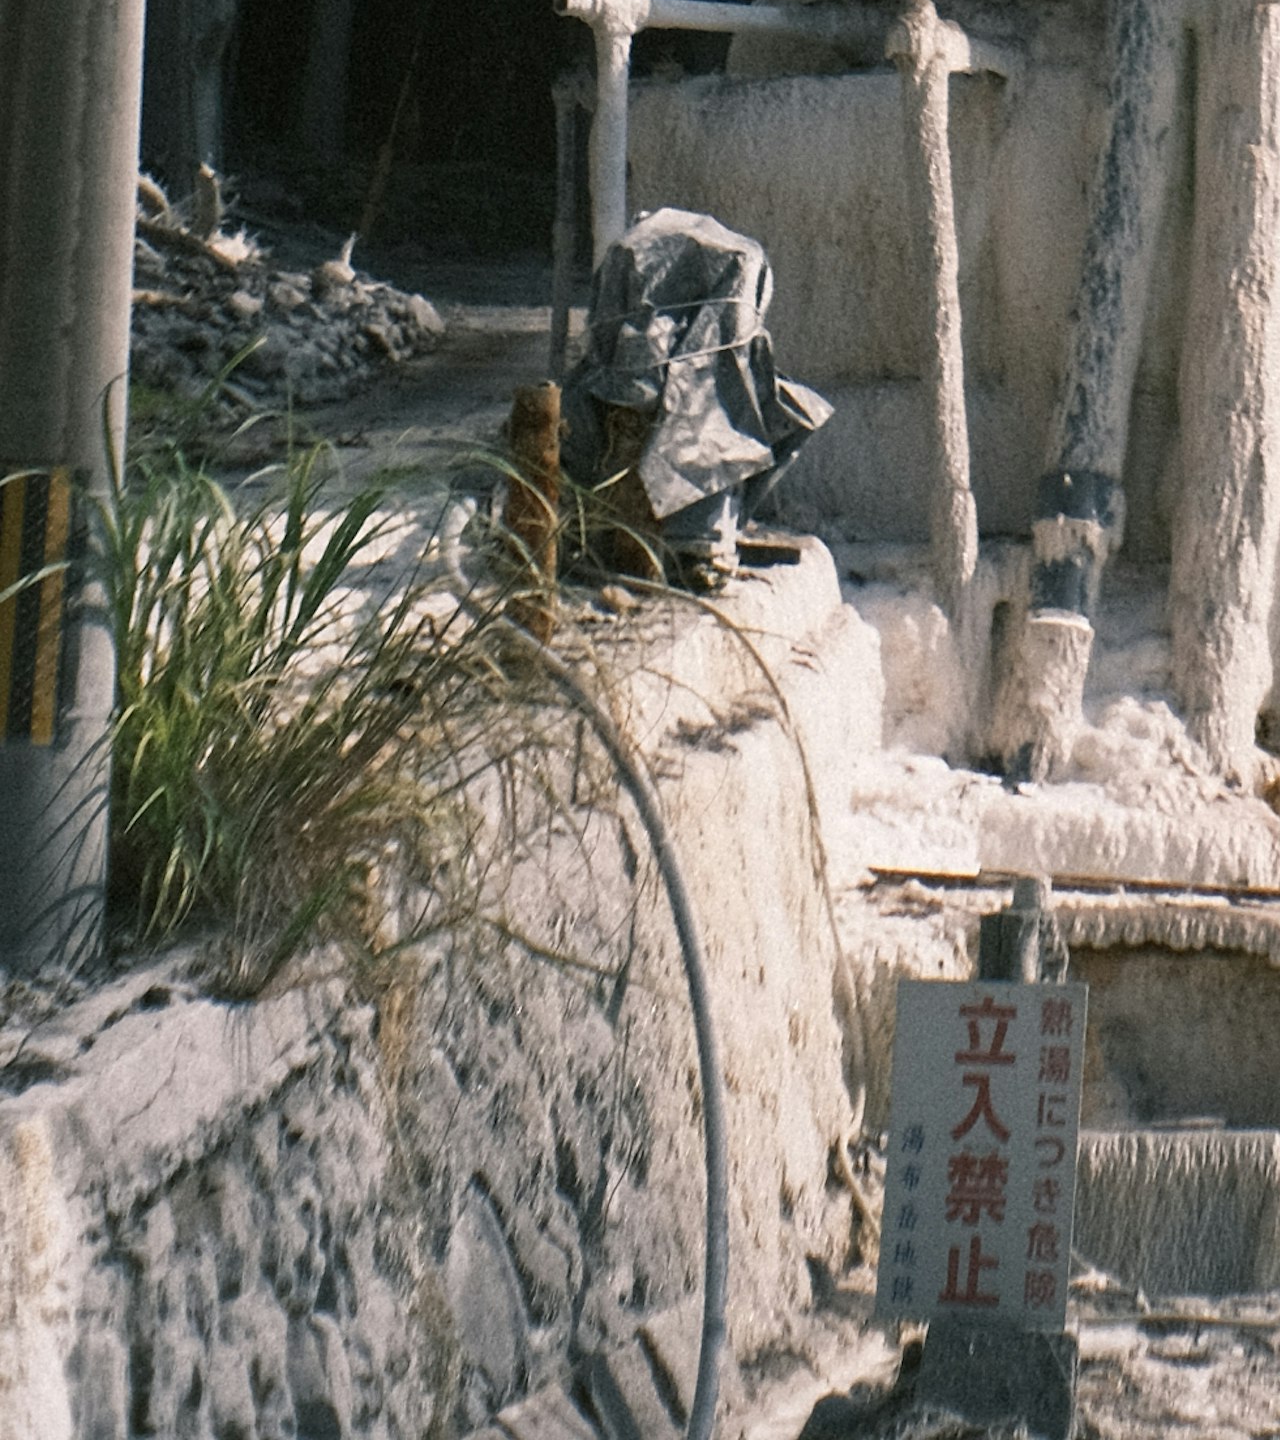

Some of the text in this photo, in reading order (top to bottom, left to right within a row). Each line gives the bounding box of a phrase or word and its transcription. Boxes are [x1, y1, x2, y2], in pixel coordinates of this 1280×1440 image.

[938, 996, 1017, 1305] 立入禁止
[1024, 997, 1073, 1308] 熱湯につき危険
